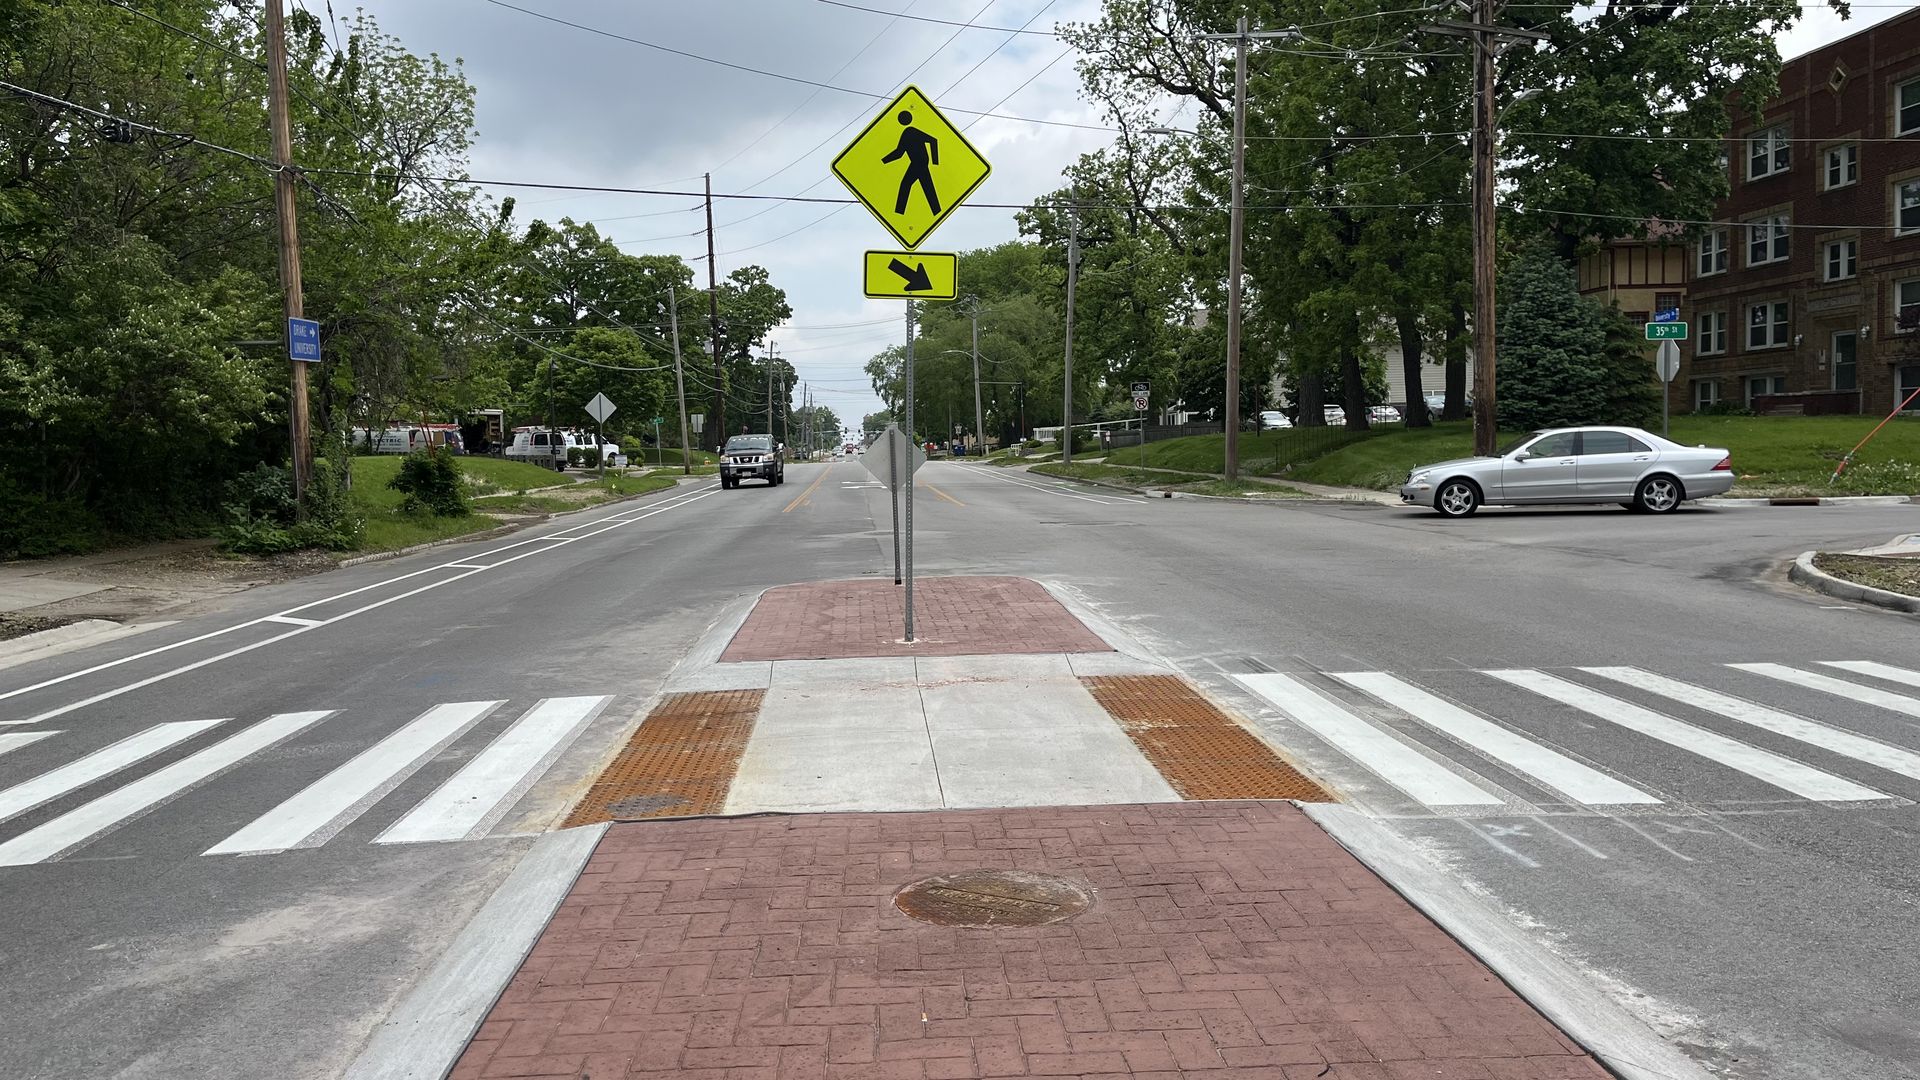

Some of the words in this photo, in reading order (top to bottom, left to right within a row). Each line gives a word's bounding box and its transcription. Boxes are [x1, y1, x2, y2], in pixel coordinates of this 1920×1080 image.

[293, 324, 307, 337] DRAKE
[1655, 326, 1670, 336] 35th
[294, 342, 317, 355] UNIVERSITY
